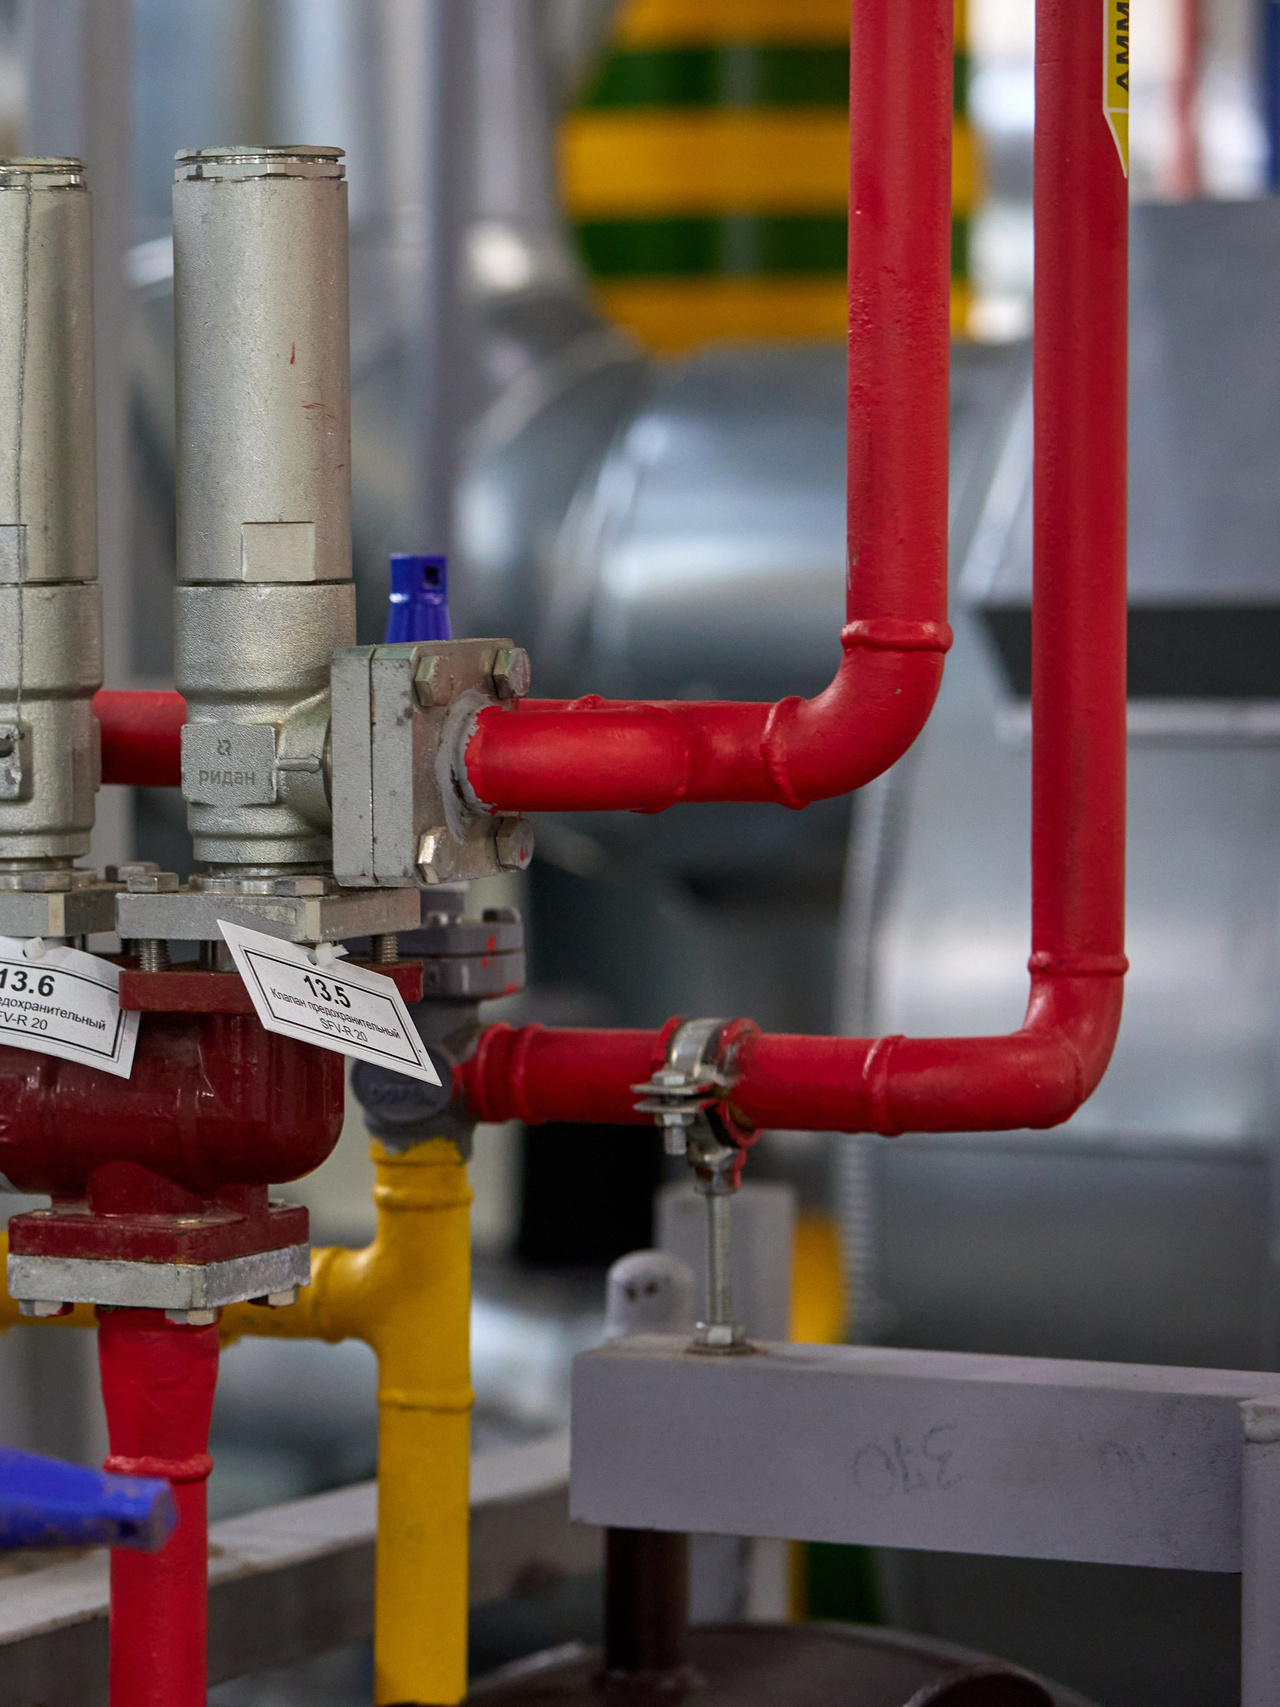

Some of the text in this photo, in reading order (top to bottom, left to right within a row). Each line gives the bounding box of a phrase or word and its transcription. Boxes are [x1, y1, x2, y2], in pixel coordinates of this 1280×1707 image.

[200, 770, 255, 787] ридан
[303, 975, 352, 1008] 13.5
[30, 1017, 48, 1031] 20
[270, 987, 402, 1040] Клапан предохранительный
[319, 1018, 368, 1043] SFV-R 20
